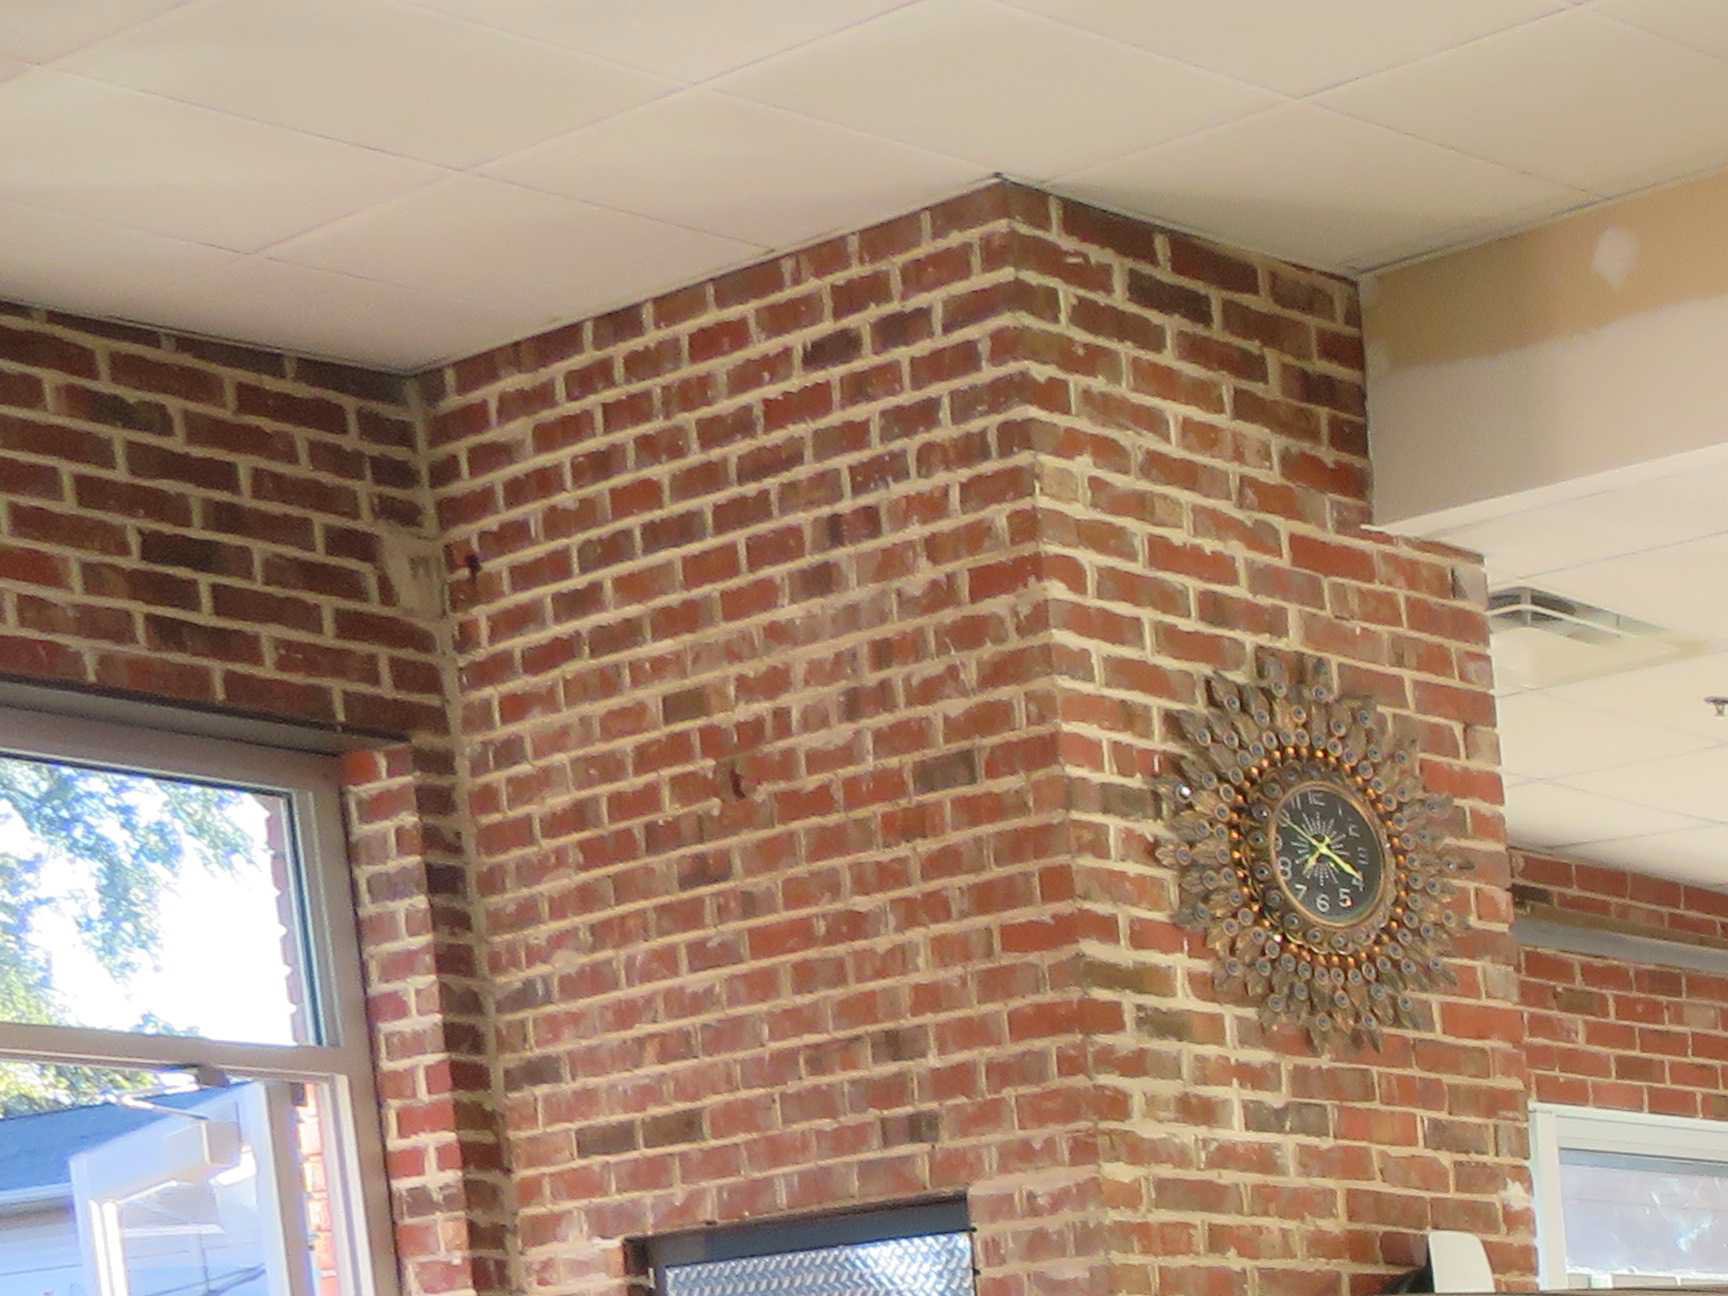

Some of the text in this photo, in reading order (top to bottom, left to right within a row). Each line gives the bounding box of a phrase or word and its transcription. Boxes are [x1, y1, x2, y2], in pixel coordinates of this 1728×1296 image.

[1279, 855, 1293, 881] 8
[1294, 883, 1308, 901] 7
[1338, 887, 1353, 908] 5
[1315, 893, 1331, 913] 6
